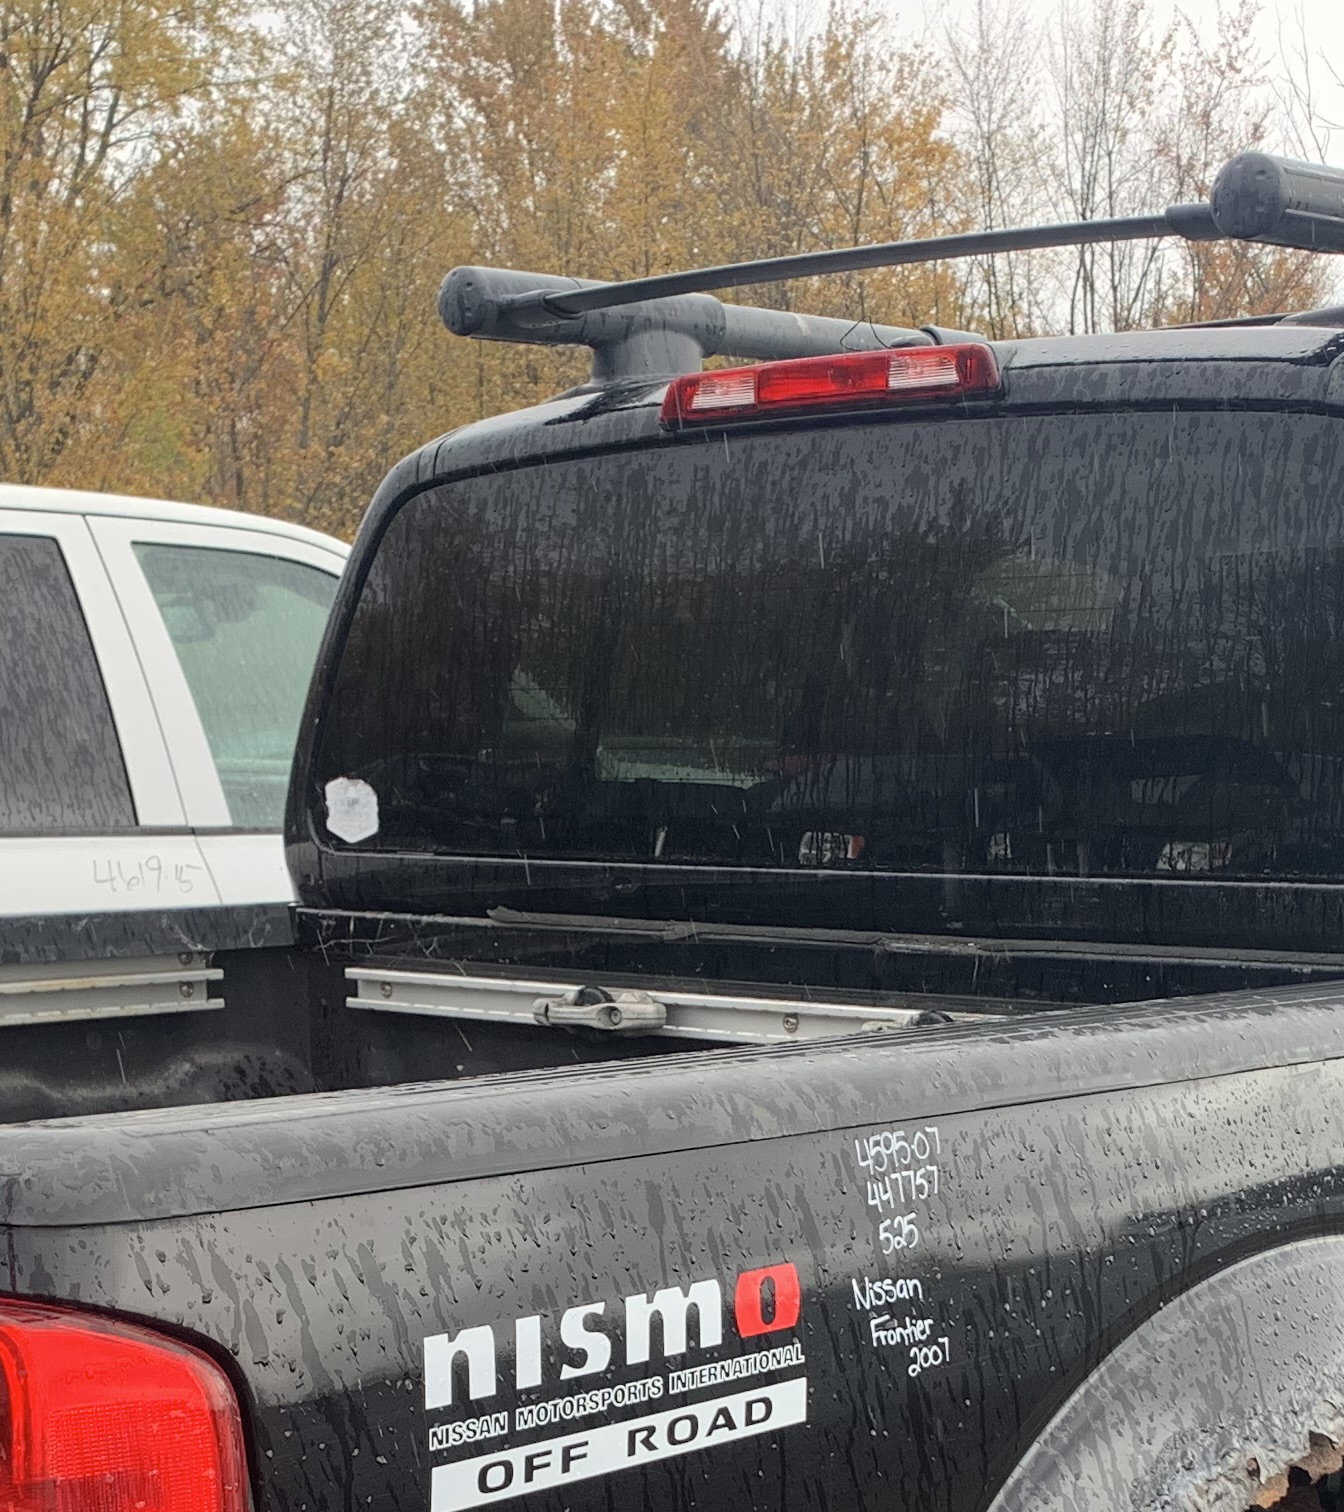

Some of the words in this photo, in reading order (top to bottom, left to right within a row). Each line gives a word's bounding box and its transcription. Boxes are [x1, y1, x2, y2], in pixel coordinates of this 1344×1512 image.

[854, 1126, 941, 1175] 4595.07
[866, 1165, 939, 1213] 447757
[878, 1212, 919, 1254] 525
[851, 1275, 923, 1311] Nissan
[869, 1314, 934, 1347] Frontier
[908, 1336, 950, 1377] 2007
[429, 1411, 509, 1452] NISSAN
[515, 1375, 664, 1431] MOTORSPORTS
[669, 1343, 806, 1395] INTERNATIONAL
[477, 1440, 590, 1495] OFF
[626, 1396, 774, 1458] ROAD
